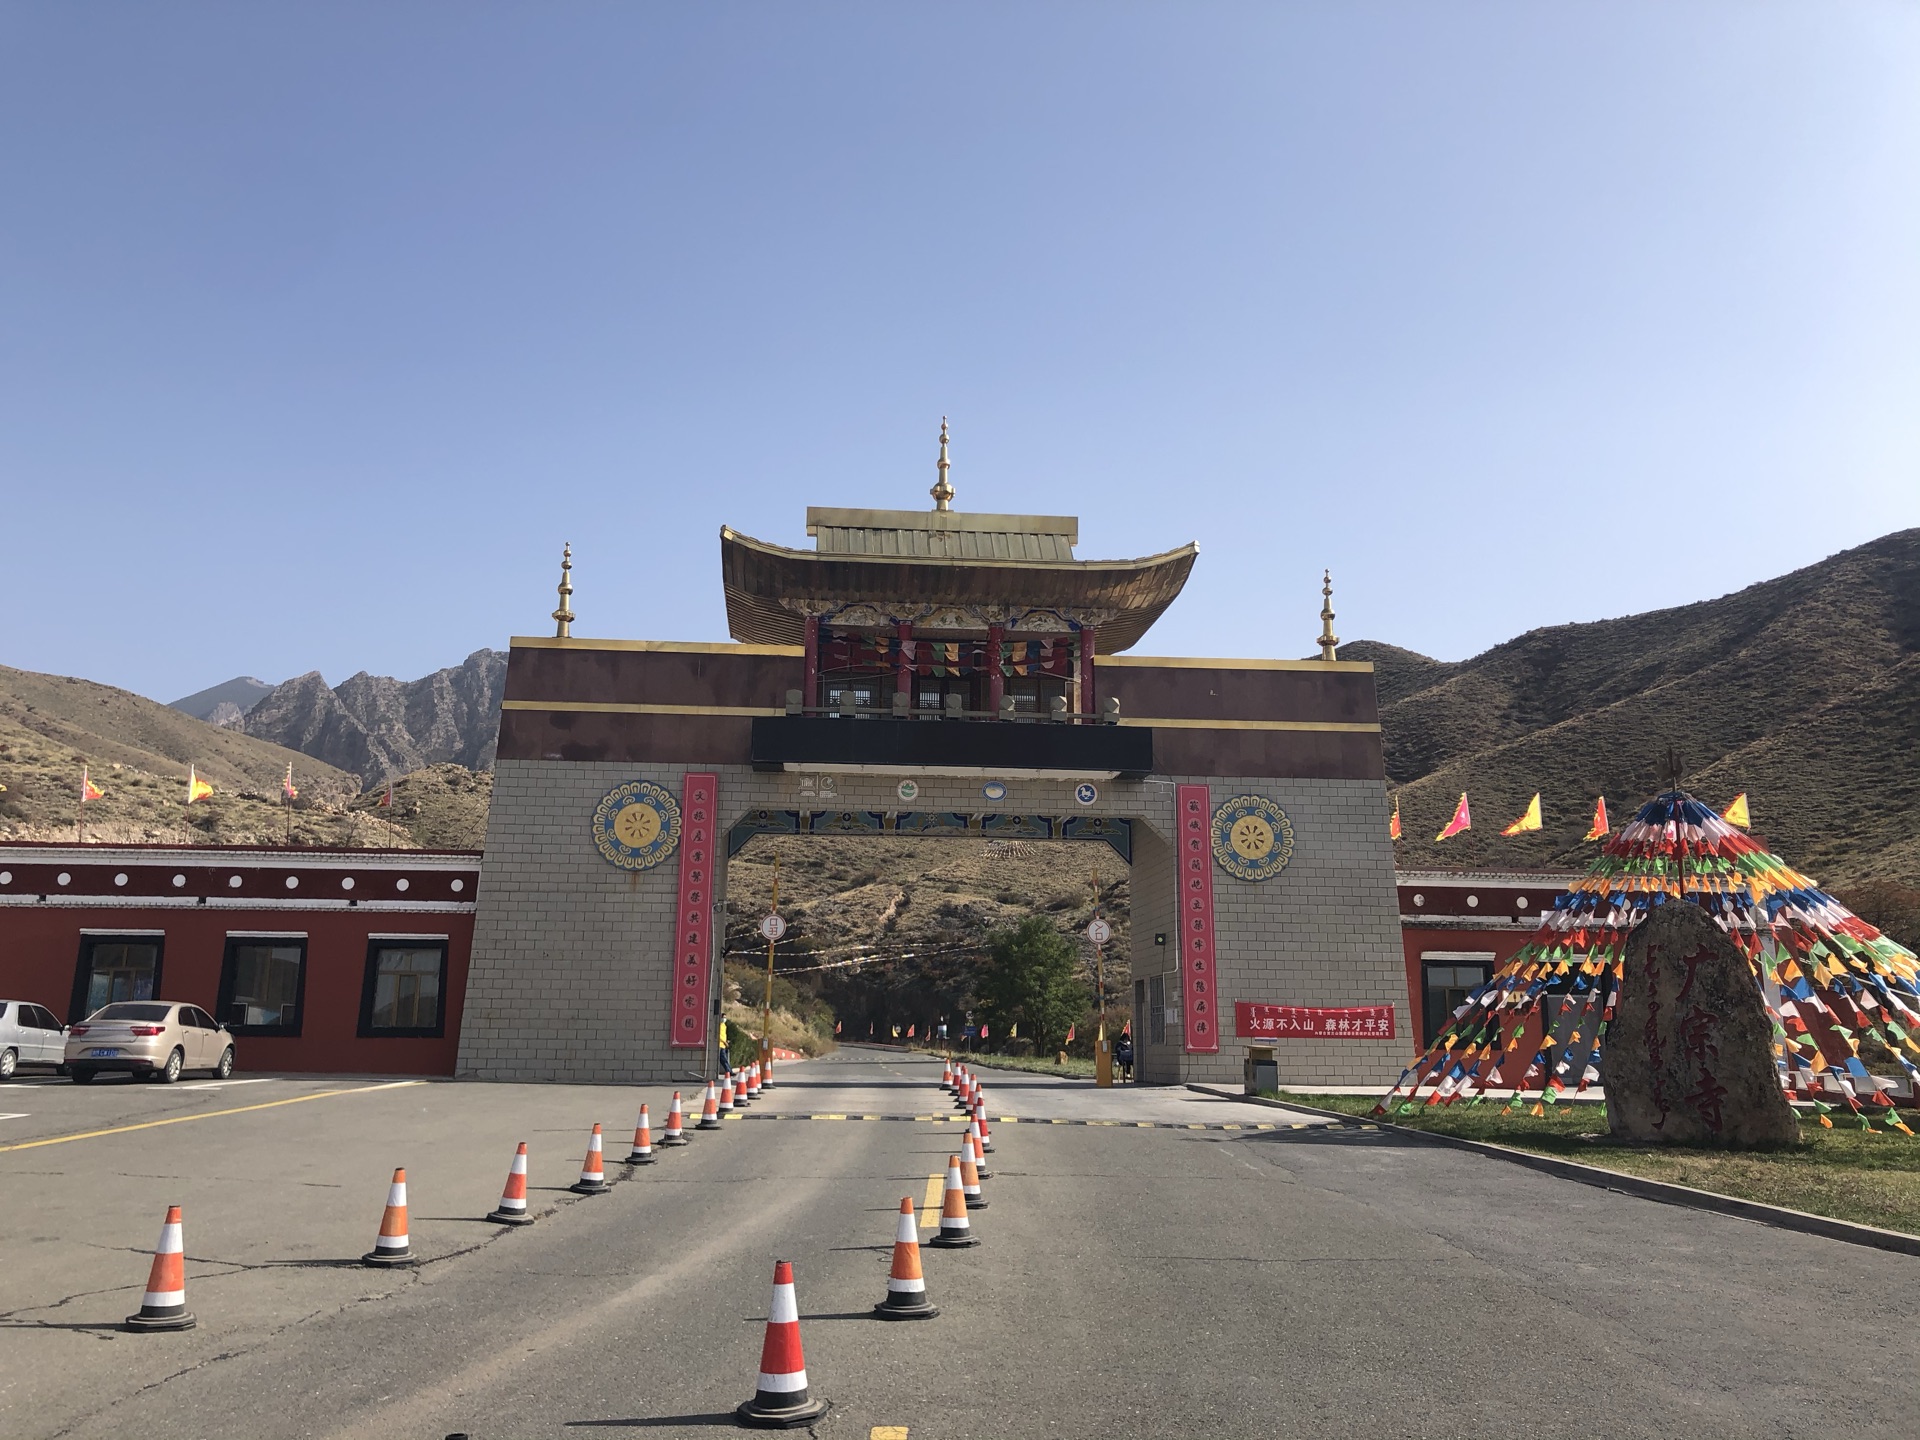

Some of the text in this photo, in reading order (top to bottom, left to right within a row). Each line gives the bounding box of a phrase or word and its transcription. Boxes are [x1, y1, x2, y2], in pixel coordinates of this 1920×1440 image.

[769, 918, 778, 935] 出口
[1094, 922, 1104, 940] 入口
[1249, 1018, 1389, 1031] 火源不入山 森林才平安
[1675, 943, 1729, 1132] 广宗寺
